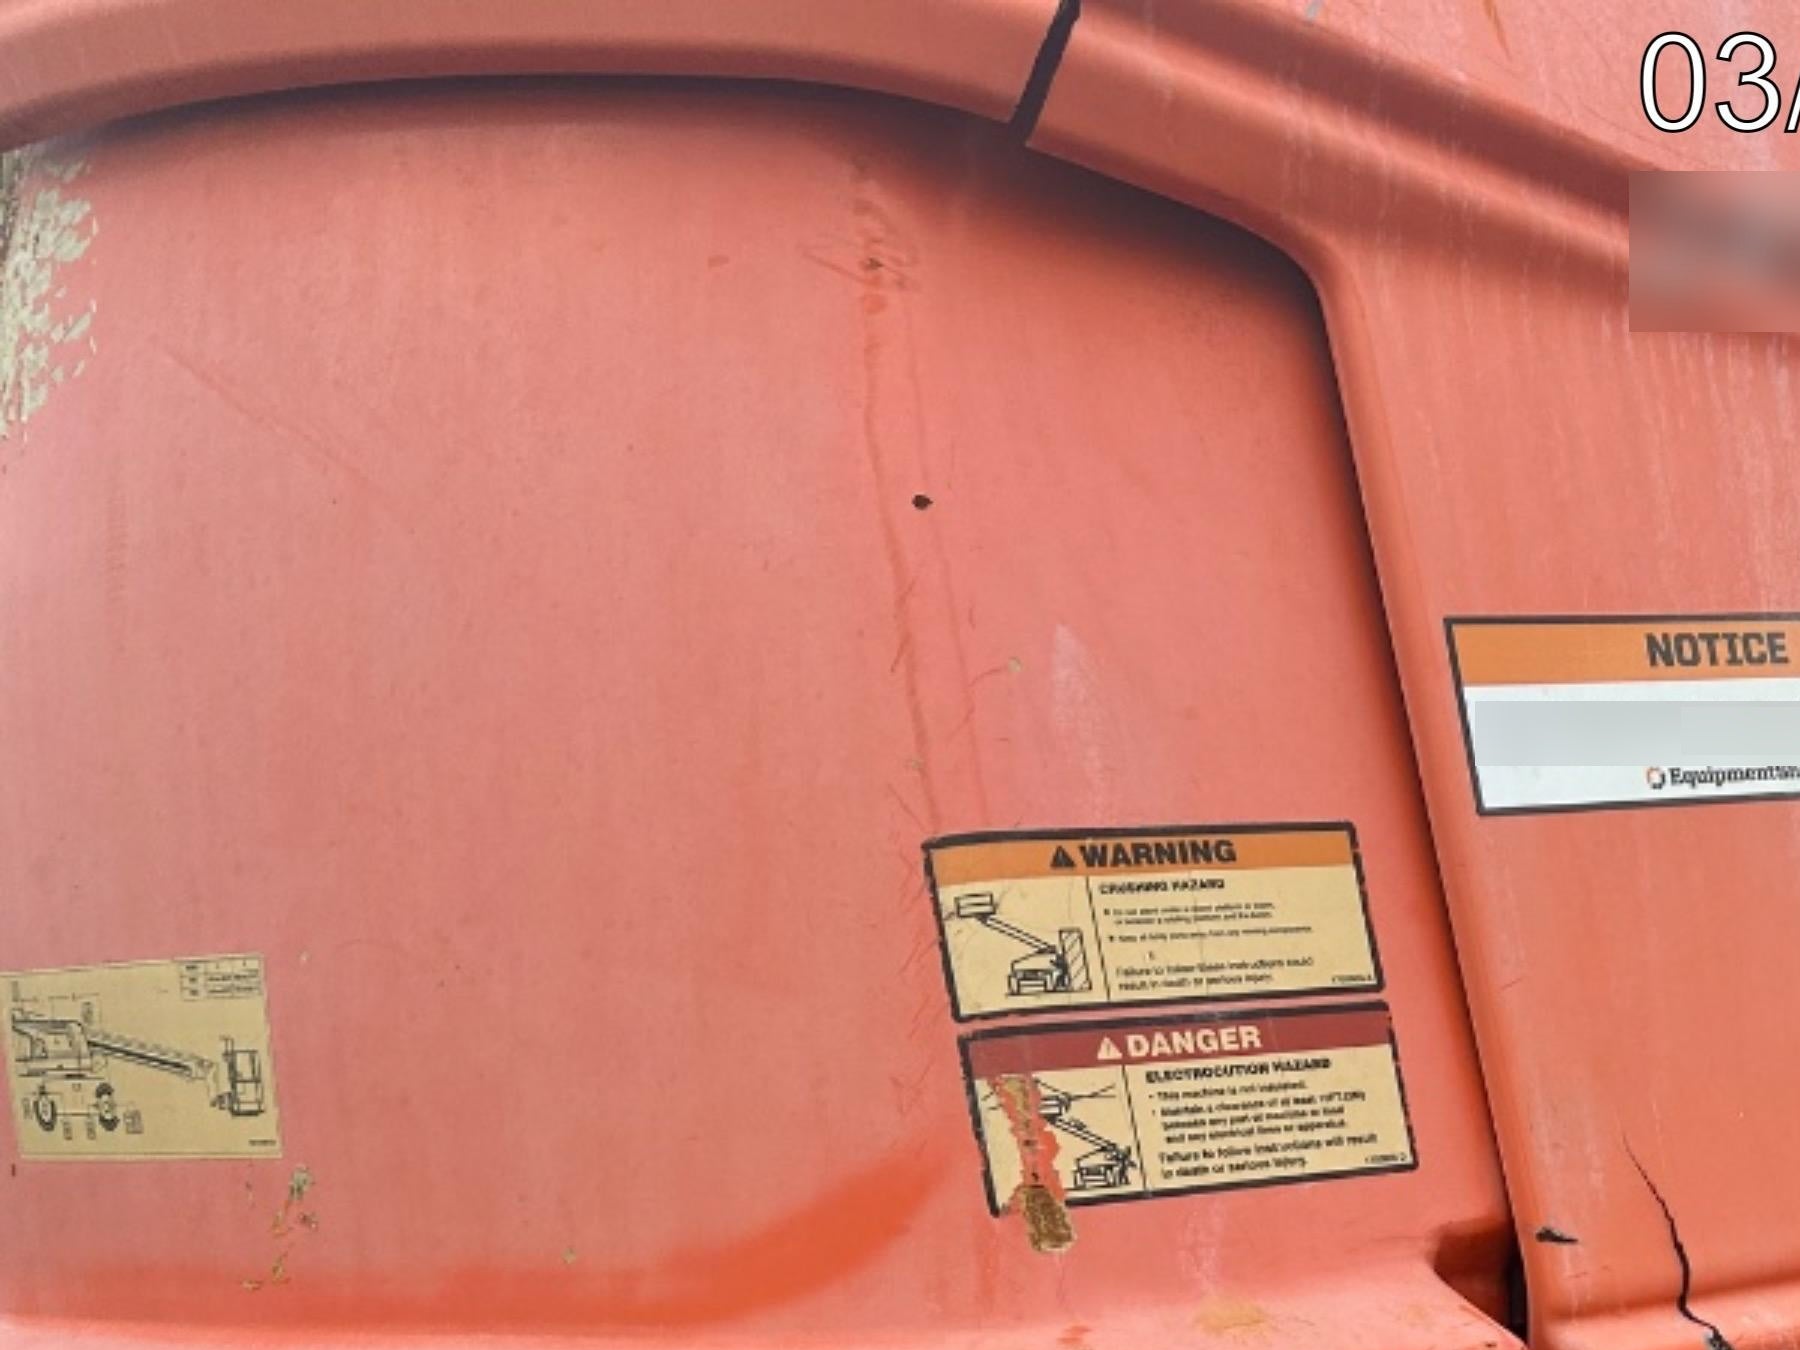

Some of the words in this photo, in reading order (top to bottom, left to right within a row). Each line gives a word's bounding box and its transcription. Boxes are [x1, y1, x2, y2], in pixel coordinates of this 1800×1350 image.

[1645, 632, 1790, 667] NOTICE
[1079, 839, 1237, 868] WARNING
[1126, 1026, 1262, 1058] DANGER
